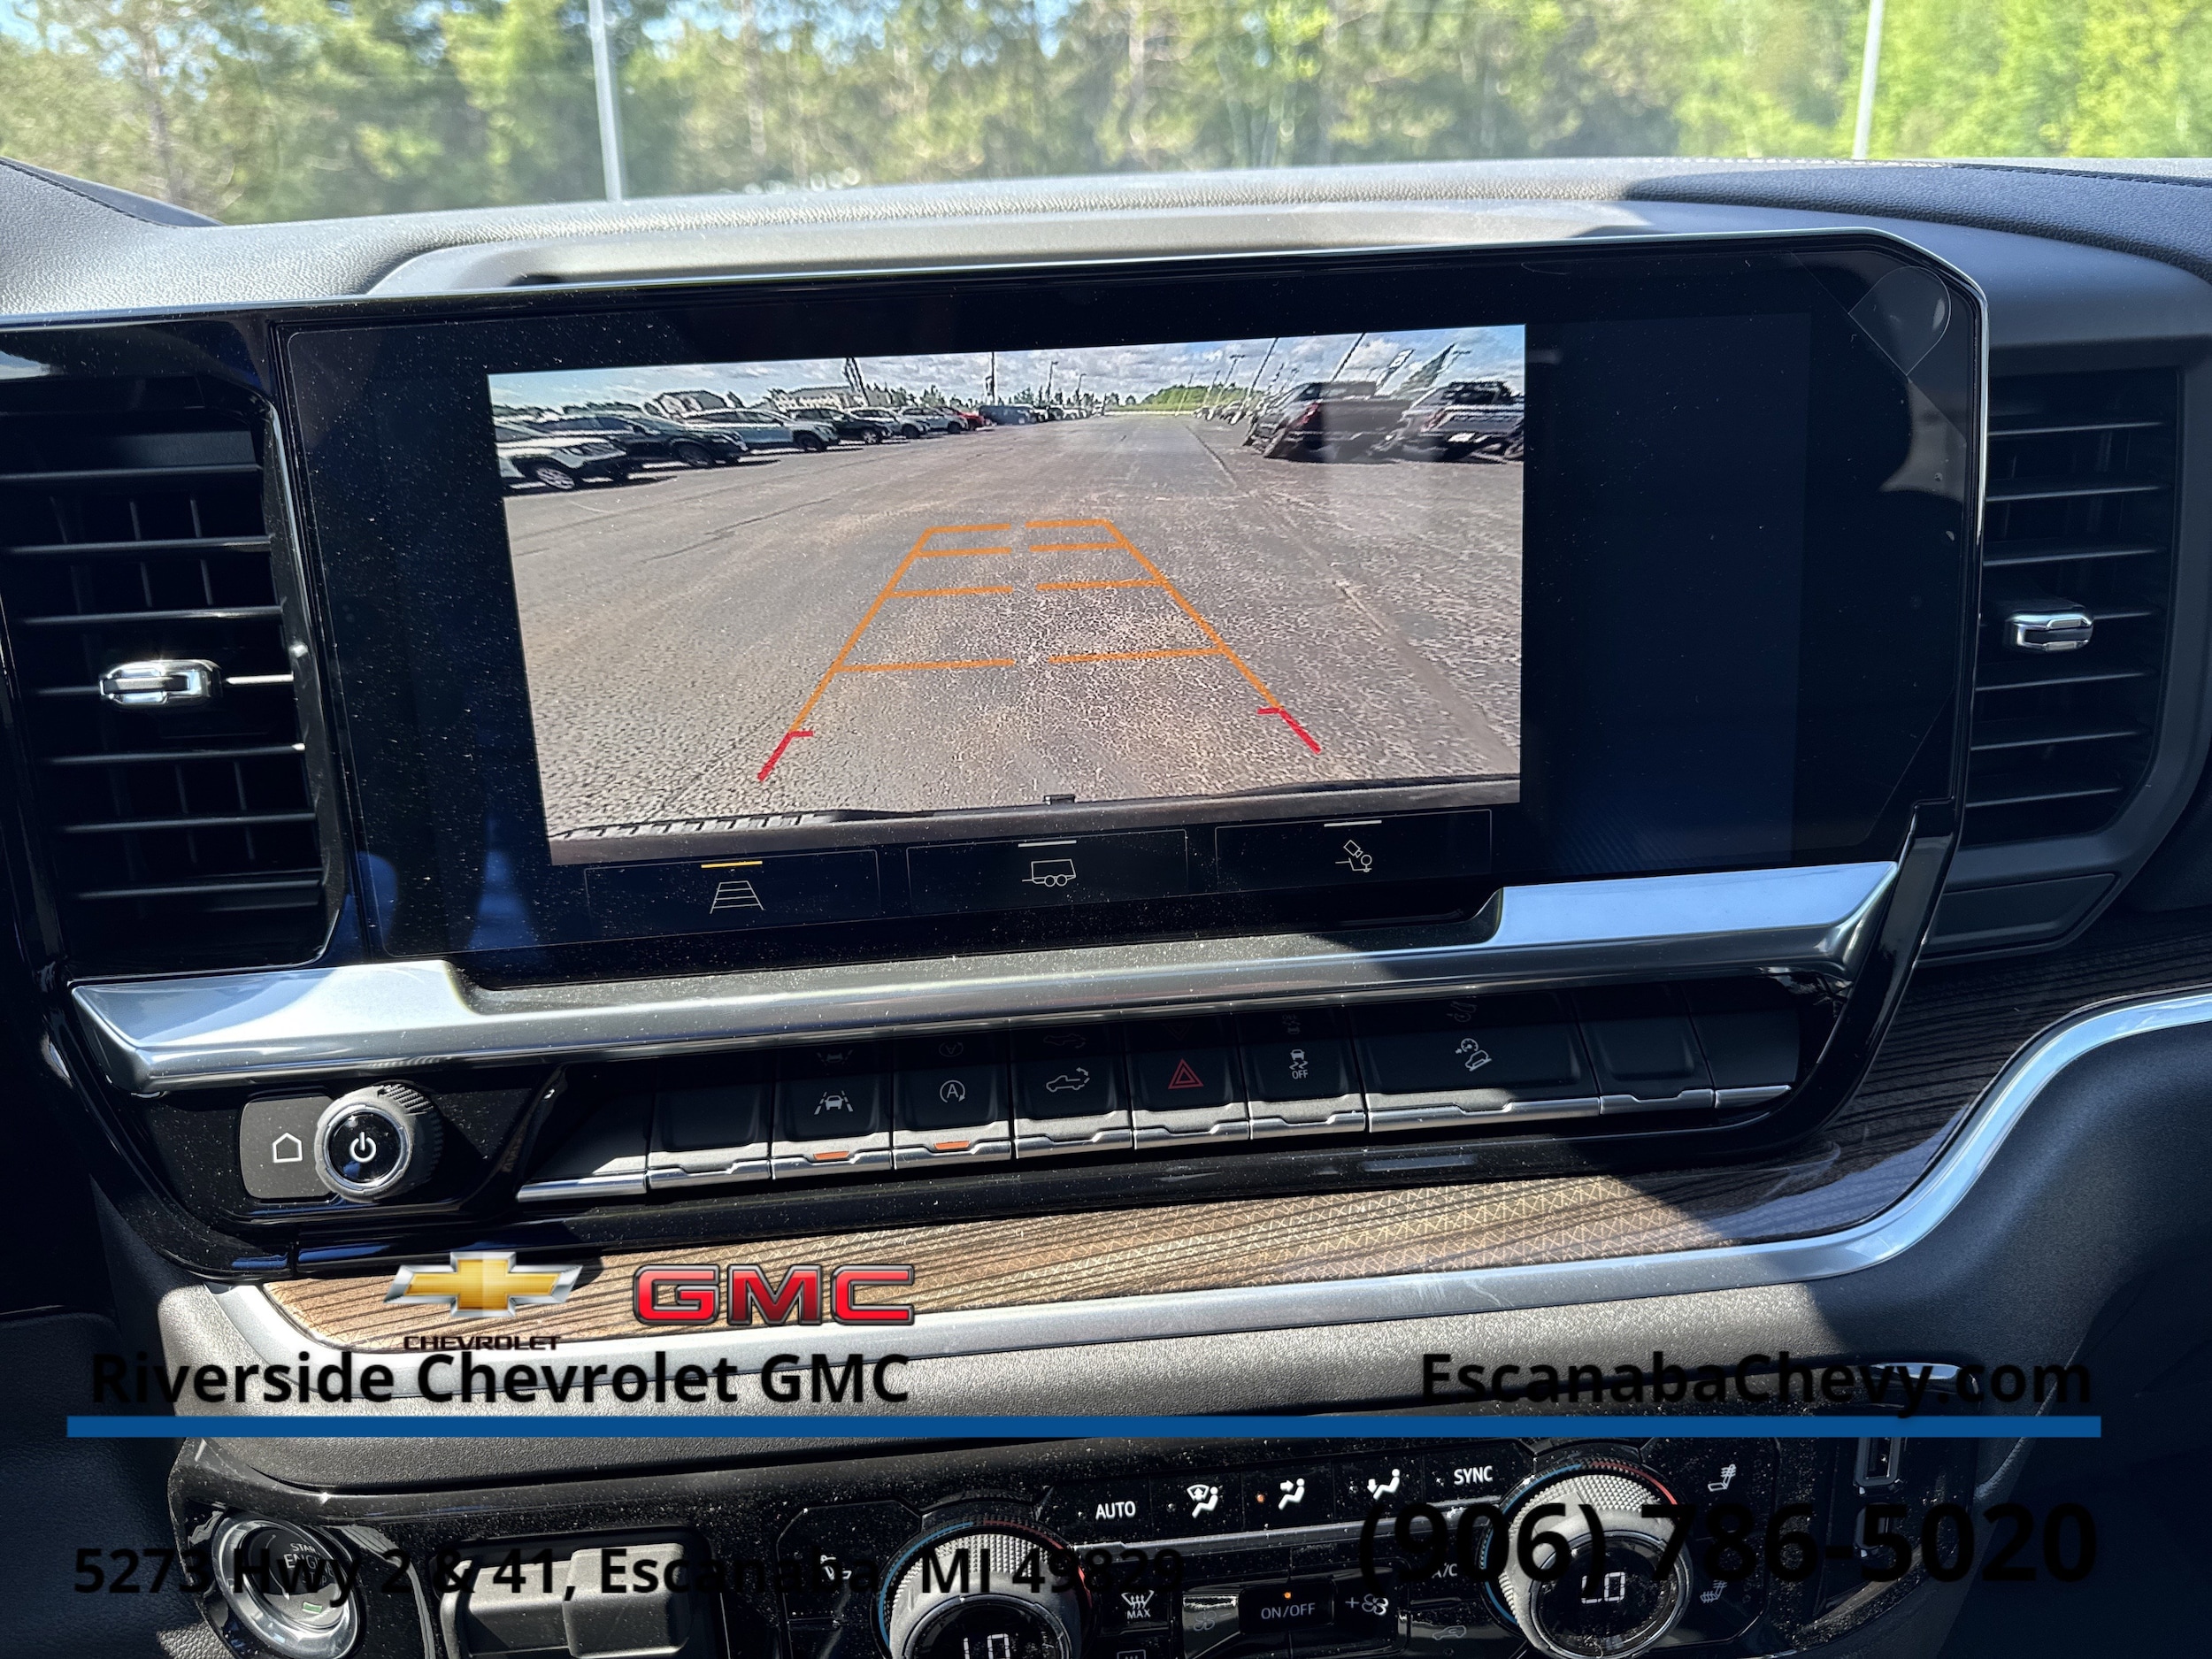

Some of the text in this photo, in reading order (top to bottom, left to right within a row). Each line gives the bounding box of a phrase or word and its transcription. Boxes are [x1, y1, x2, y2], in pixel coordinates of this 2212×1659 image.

[1291, 1069, 1309, 1080] OFF
[1453, 1465, 1494, 1486] SYNC
[1094, 1501, 1137, 1520] AUTO
[301, 1571, 328, 1586] STP
[1125, 1608, 1151, 1621] MAX
[1260, 1602, 1317, 1620] ON/OFF
